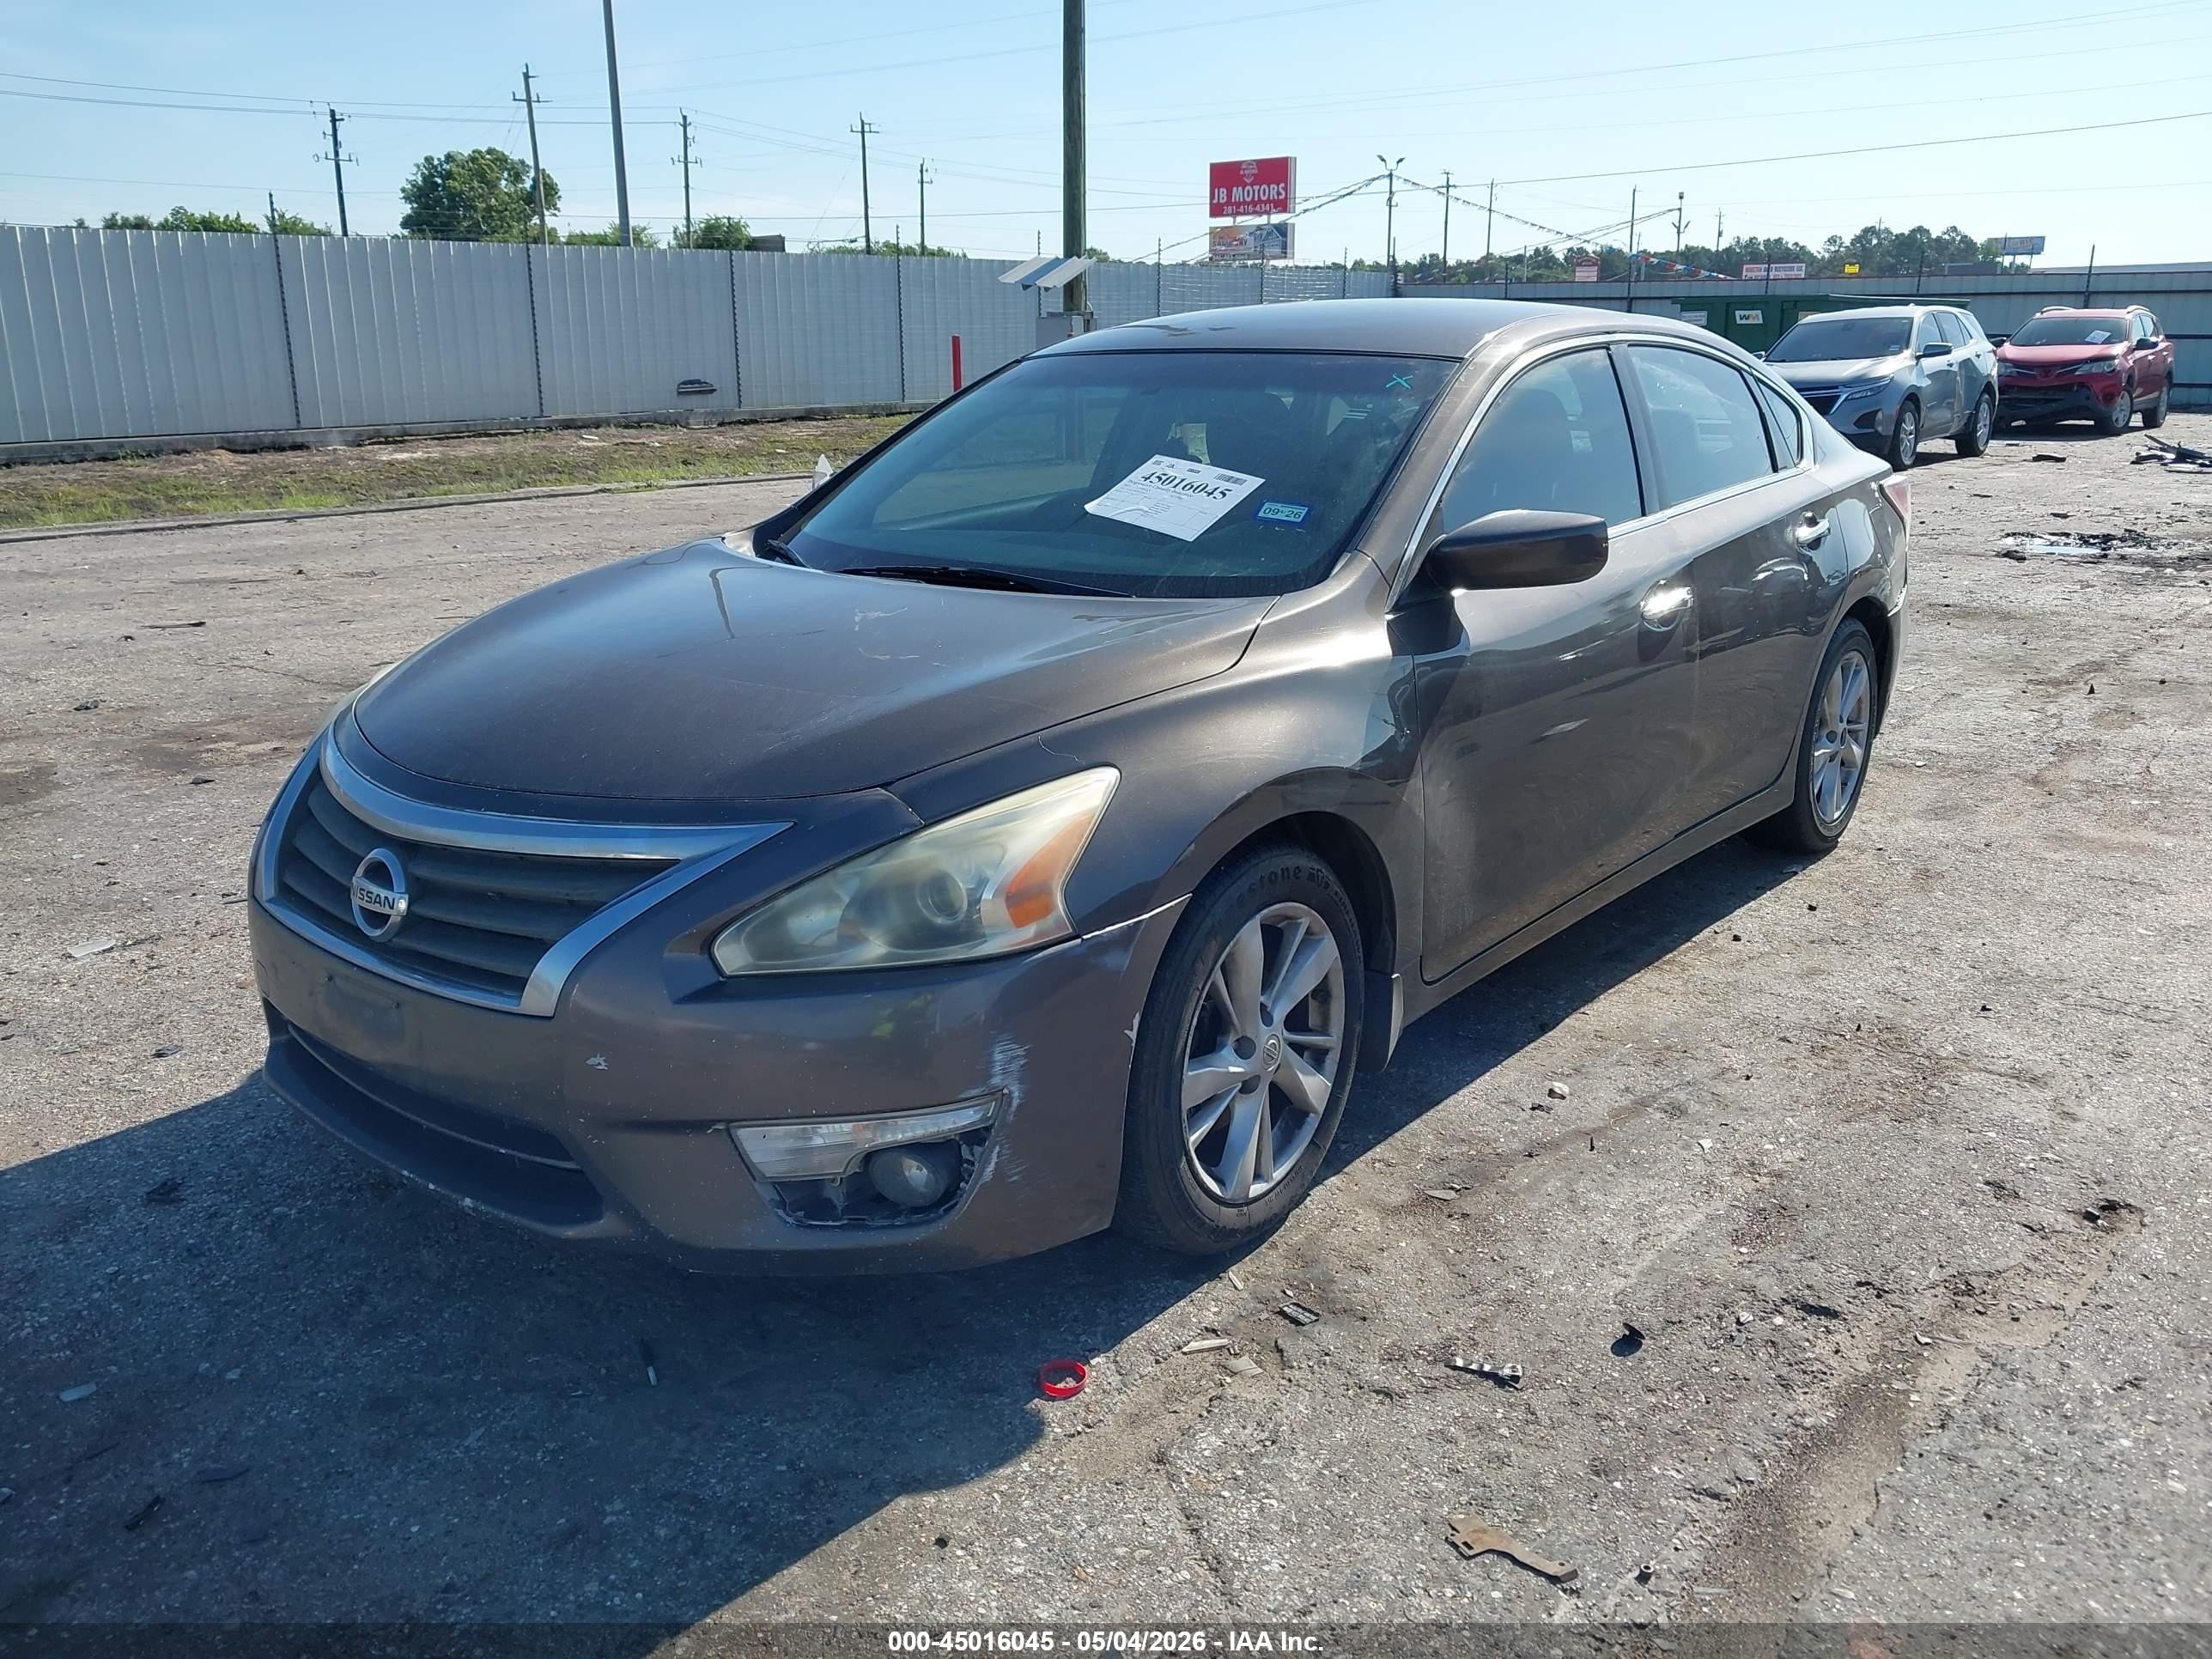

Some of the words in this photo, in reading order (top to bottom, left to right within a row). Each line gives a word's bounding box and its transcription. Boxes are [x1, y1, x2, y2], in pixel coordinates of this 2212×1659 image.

[1212, 187, 1227, 204] JB
[1231, 183, 1285, 203] MOTORS
[1223, 203, 1273, 215] 281-416-4341
[1139, 471, 1233, 501] 45016045
[1262, 507, 1280, 516] 09
[1285, 509, 1303, 520] 26
[352, 885, 395, 910] NISSAN
